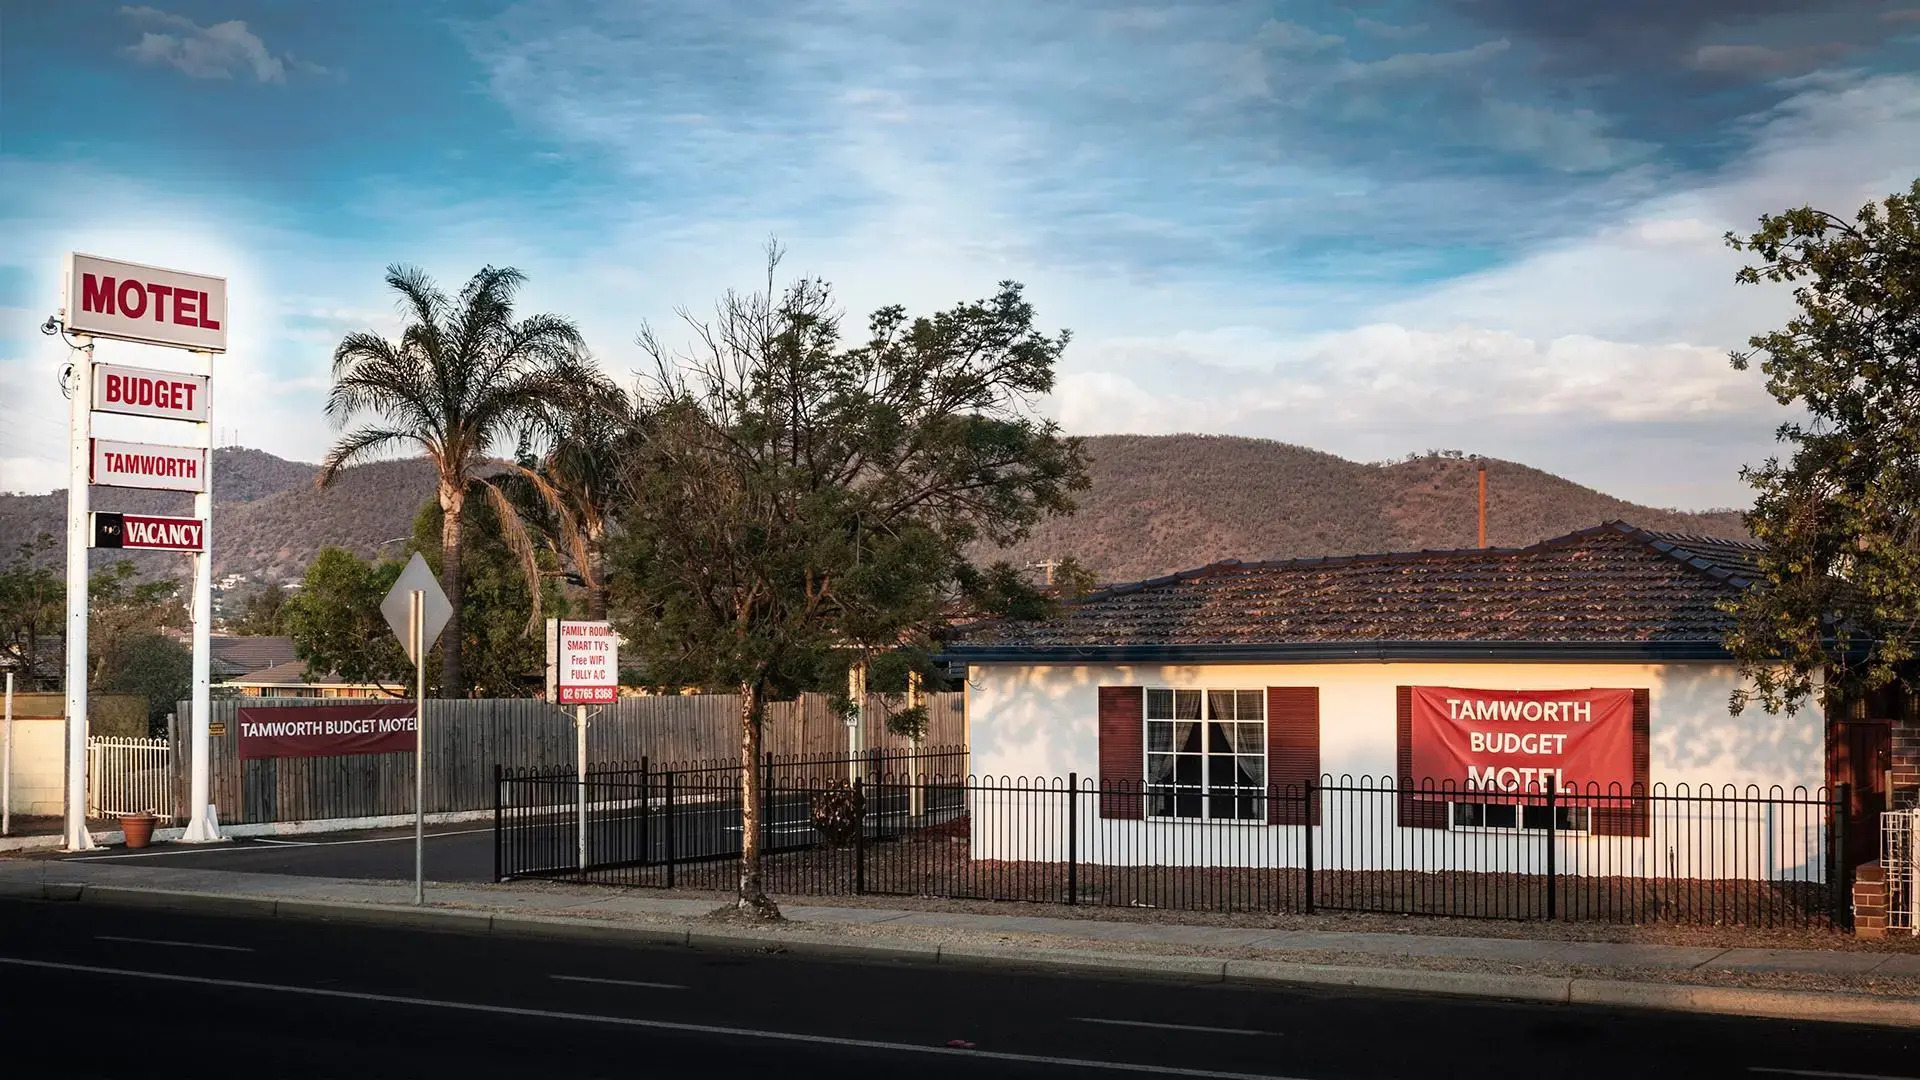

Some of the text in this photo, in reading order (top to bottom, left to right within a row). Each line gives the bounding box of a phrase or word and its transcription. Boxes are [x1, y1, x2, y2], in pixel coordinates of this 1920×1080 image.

[82, 273, 220, 331] MOTEL
[106, 374, 197, 411] BUDGET
[104, 452, 197, 478] TAMWORTH
[125, 521, 201, 546] VACANCY
[562, 626, 587, 636] FAMILY
[567, 640, 609, 651] SMART TV's
[571, 655, 605, 665] Free WIFI
[571, 669, 606, 680] FULLY A/C
[563, 688, 613, 700] 02 6765 8368
[1446, 699, 1591, 722] TAMWORTH
[241, 721, 323, 737] TAMWORTH
[325, 719, 377, 735] BUDGET
[378, 717, 418, 732] MOTEL
[1470, 732, 1567, 755] BUDGET
[1467, 765, 1571, 793] MOTEL
